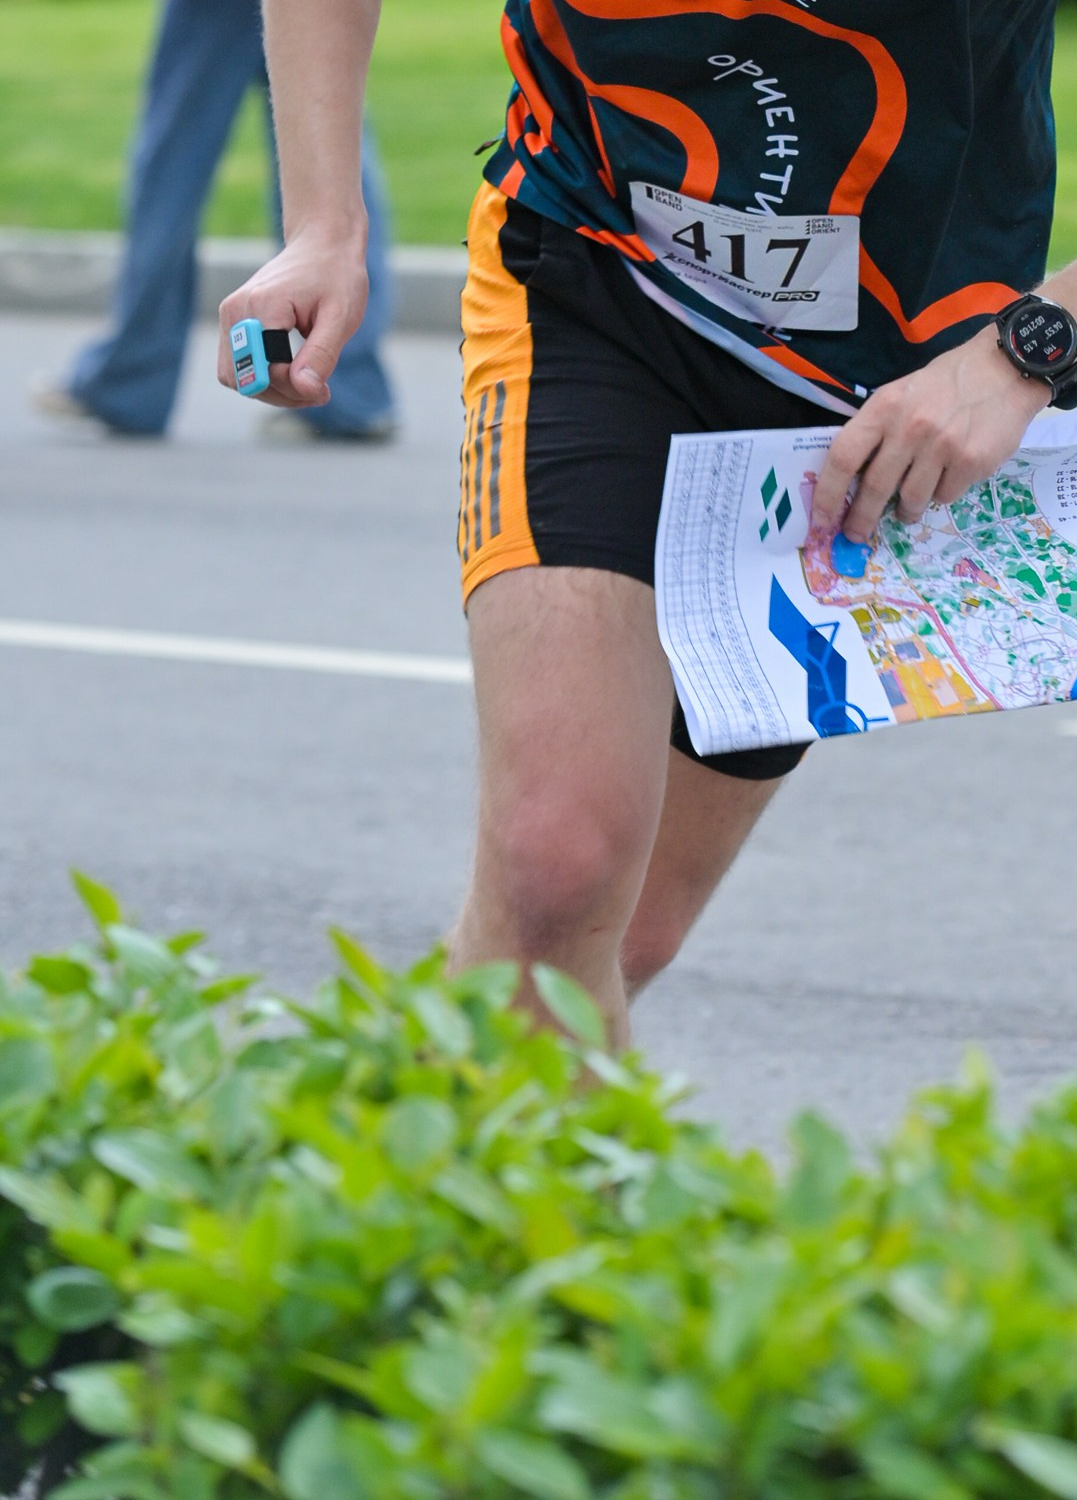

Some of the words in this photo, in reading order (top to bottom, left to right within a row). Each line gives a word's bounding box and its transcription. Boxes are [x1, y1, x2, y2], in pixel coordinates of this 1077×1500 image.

[654, 188, 682, 204] OPEN
[655, 194, 683, 212] BAND
[672, 220, 812, 288] 417
[775, 291, 817, 302] PRO
